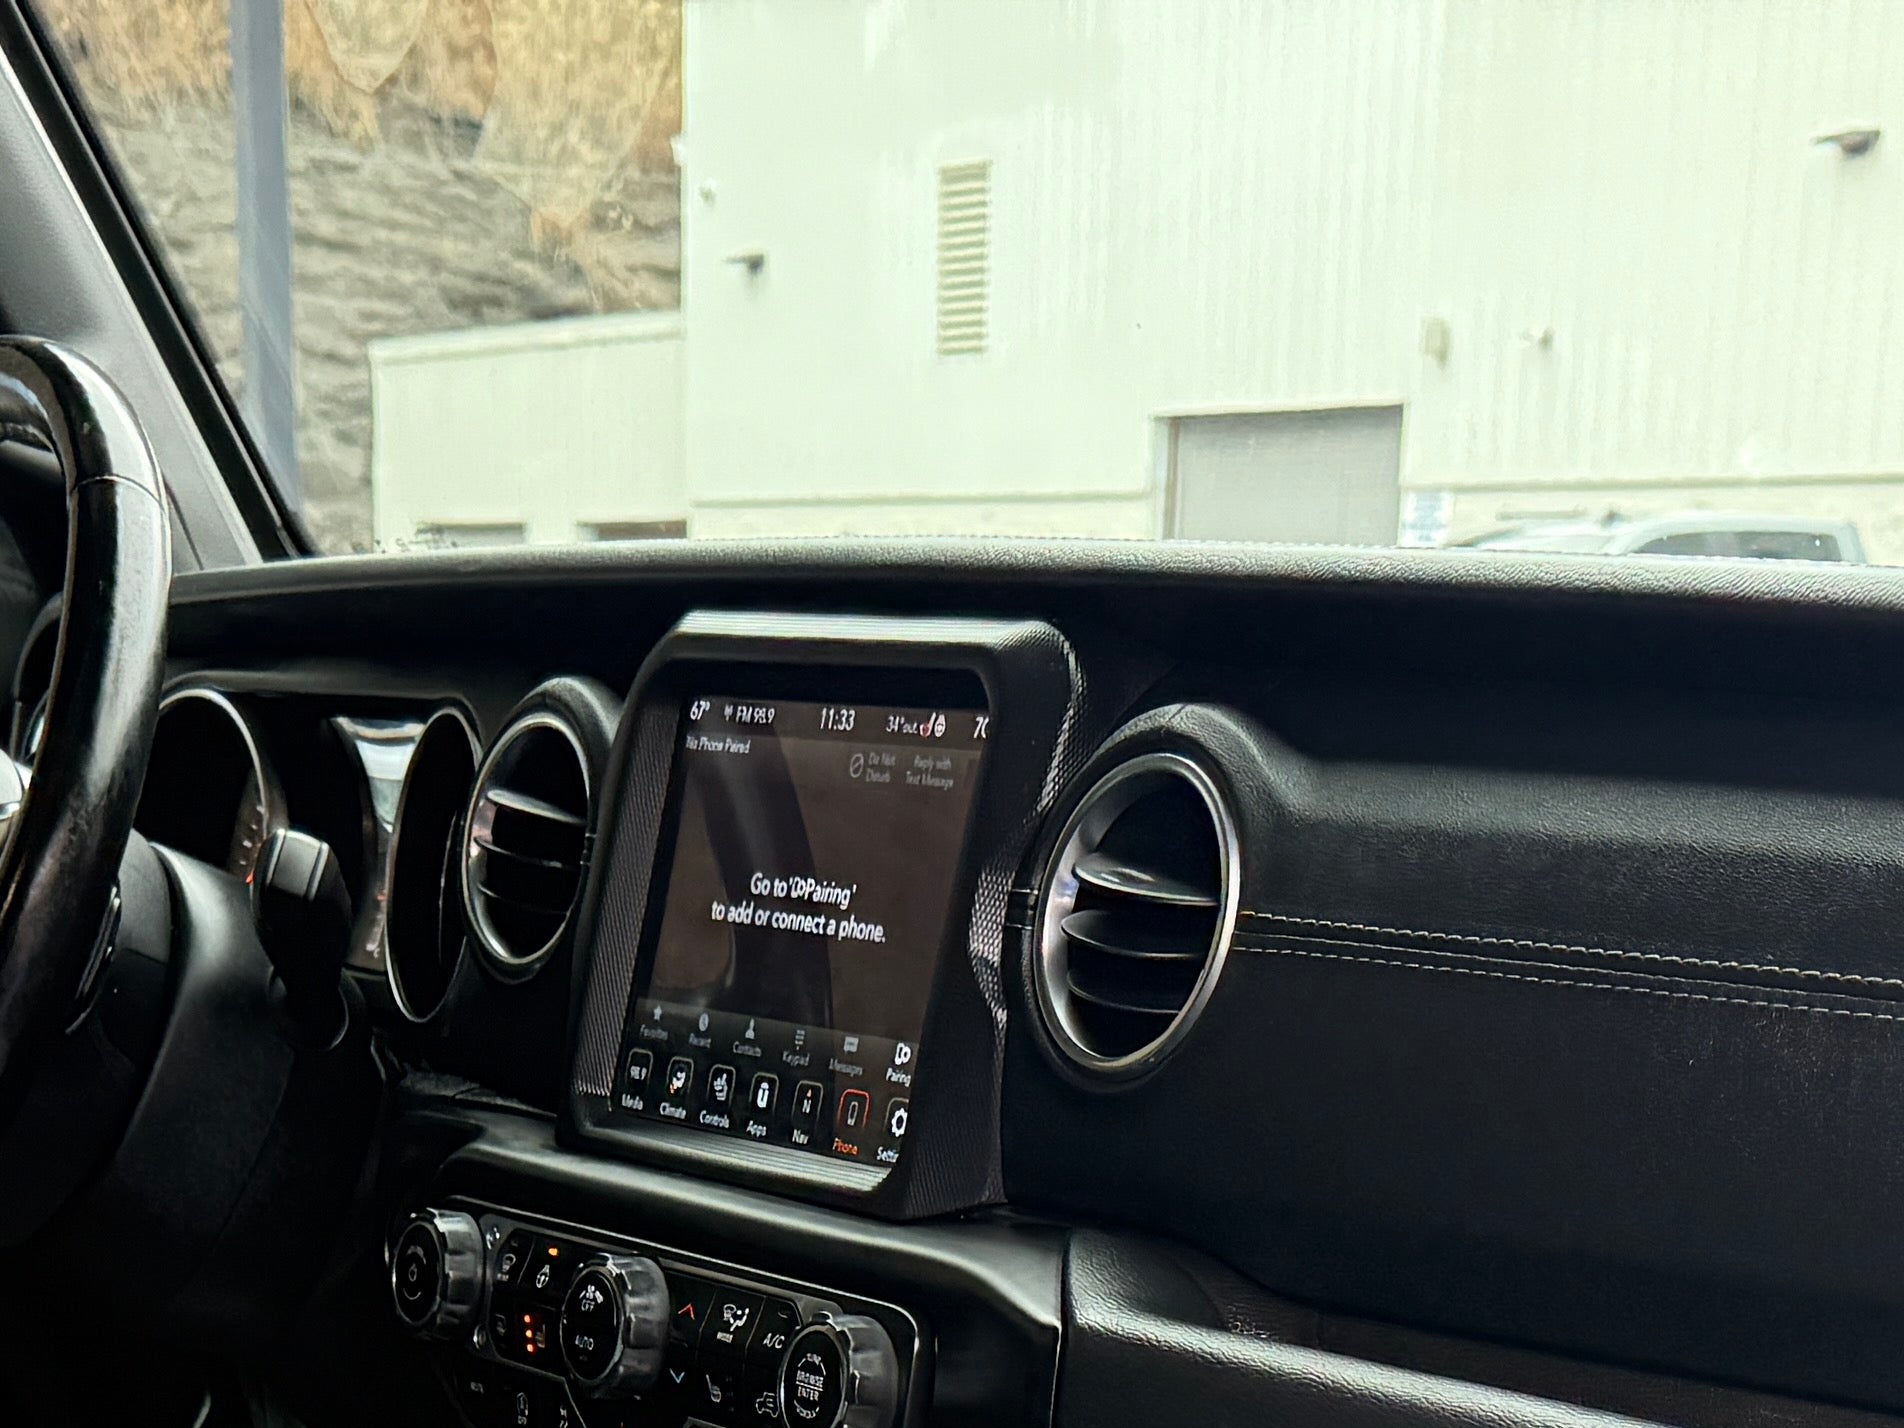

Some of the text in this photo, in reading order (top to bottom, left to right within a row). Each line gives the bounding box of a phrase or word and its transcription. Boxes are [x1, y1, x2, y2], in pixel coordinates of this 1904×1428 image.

[820, 707, 856, 731] 11:33
[750, 872, 771, 897] Go
[773, 878, 788, 898] to
[711, 900, 886, 943] to add or connect a phone.
[699, 1110, 730, 1129] Controls
[746, 1120, 767, 1138] Apps
[762, 1332, 786, 1349] A/C
